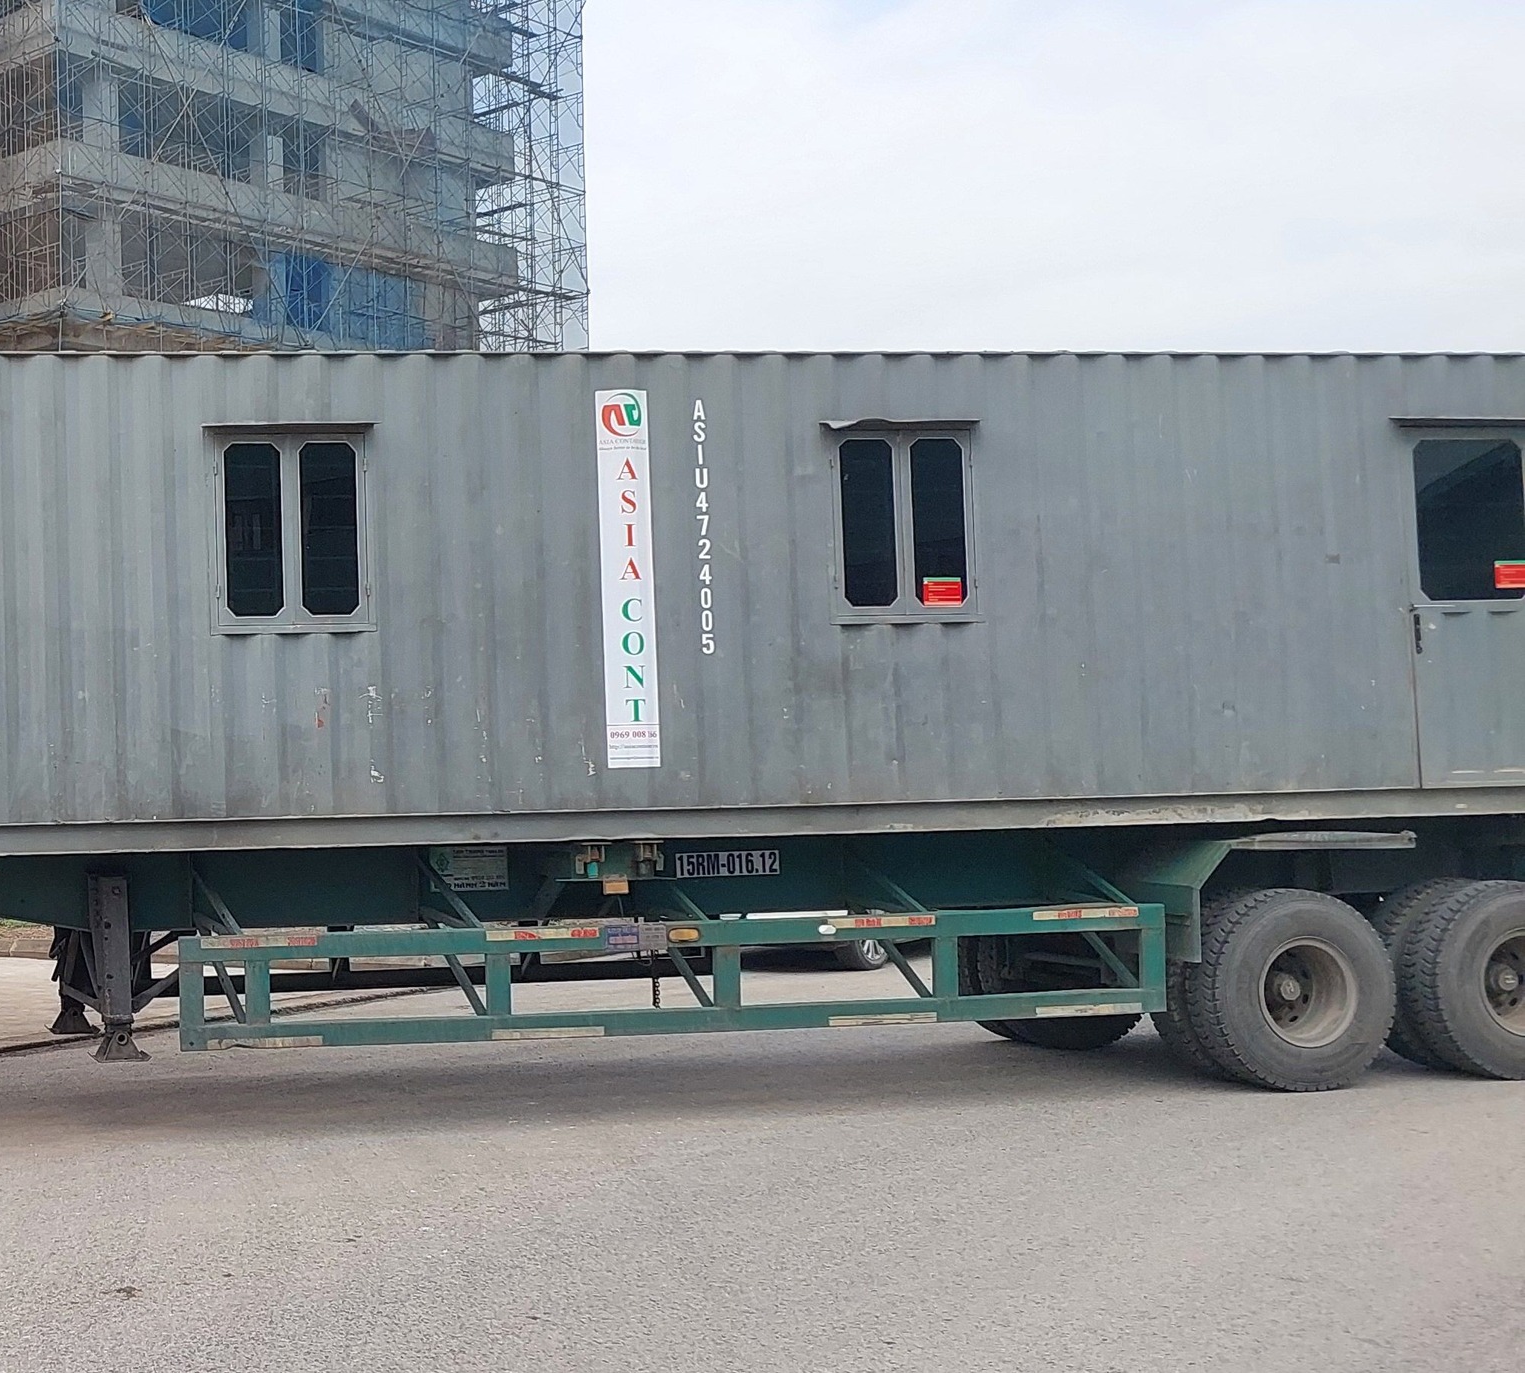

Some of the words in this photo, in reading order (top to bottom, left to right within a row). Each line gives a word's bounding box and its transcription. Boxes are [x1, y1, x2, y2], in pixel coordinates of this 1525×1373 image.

[616, 456, 642, 581] ASIA
[620, 597, 646, 723] CONT
[610, 731, 630, 739] 0969
[677, 850, 779, 878] 15RM-016.12
